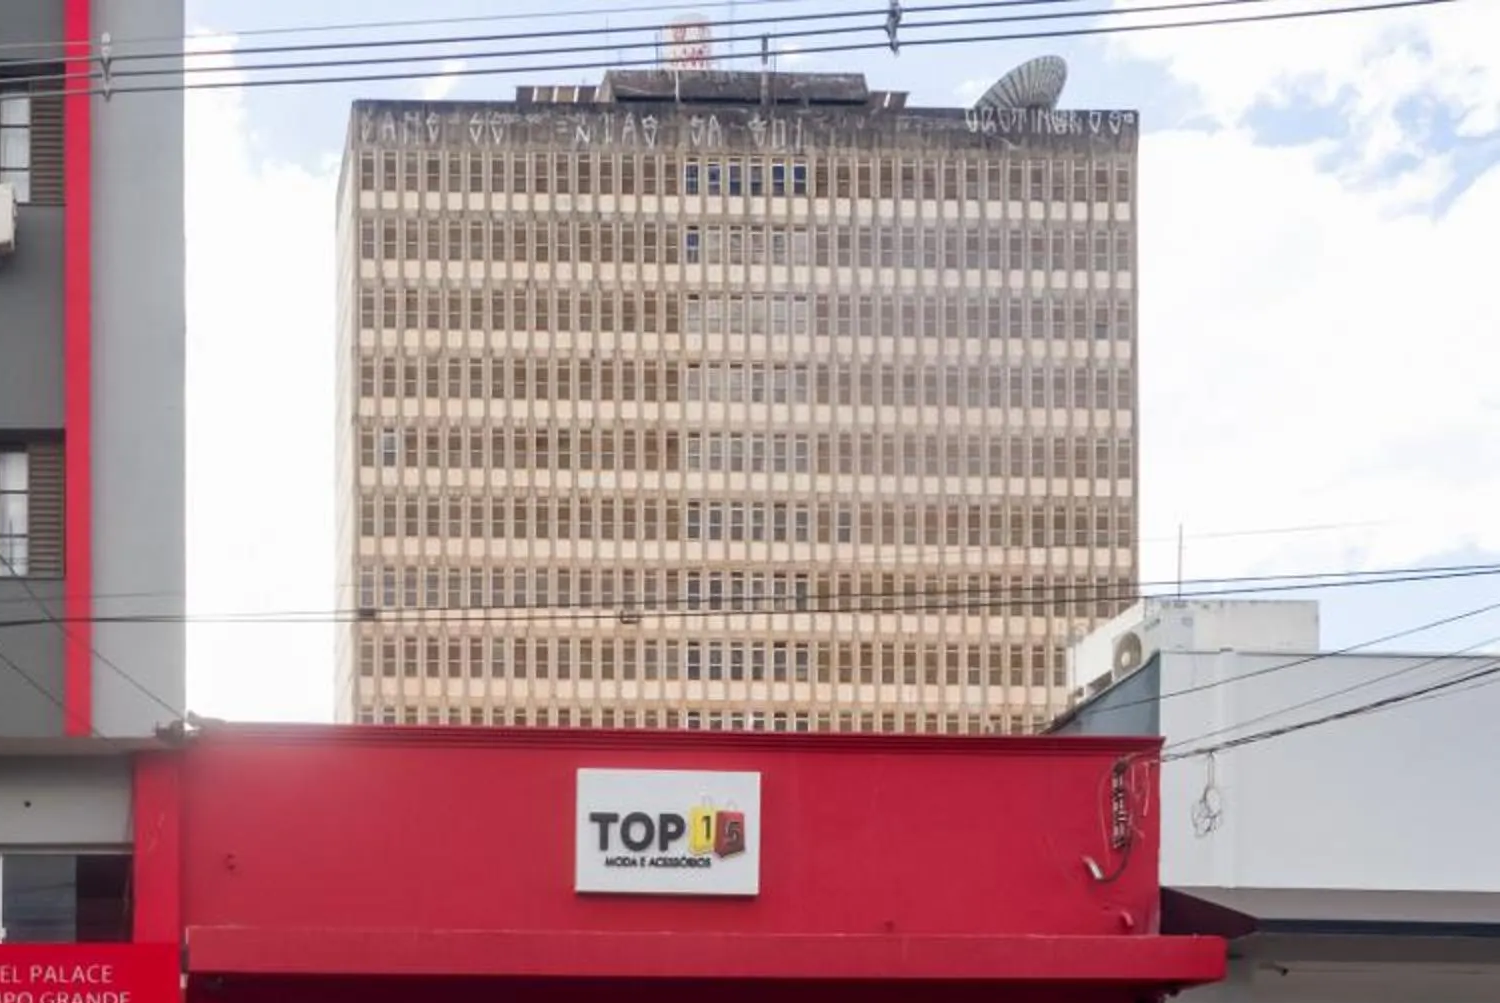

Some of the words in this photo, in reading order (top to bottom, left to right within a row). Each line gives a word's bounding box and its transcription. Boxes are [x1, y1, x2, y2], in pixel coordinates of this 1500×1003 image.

[589, 811, 686, 852] TOP
[605, 856, 637, 867] MODA
[30, 964, 114, 984] PALACE
